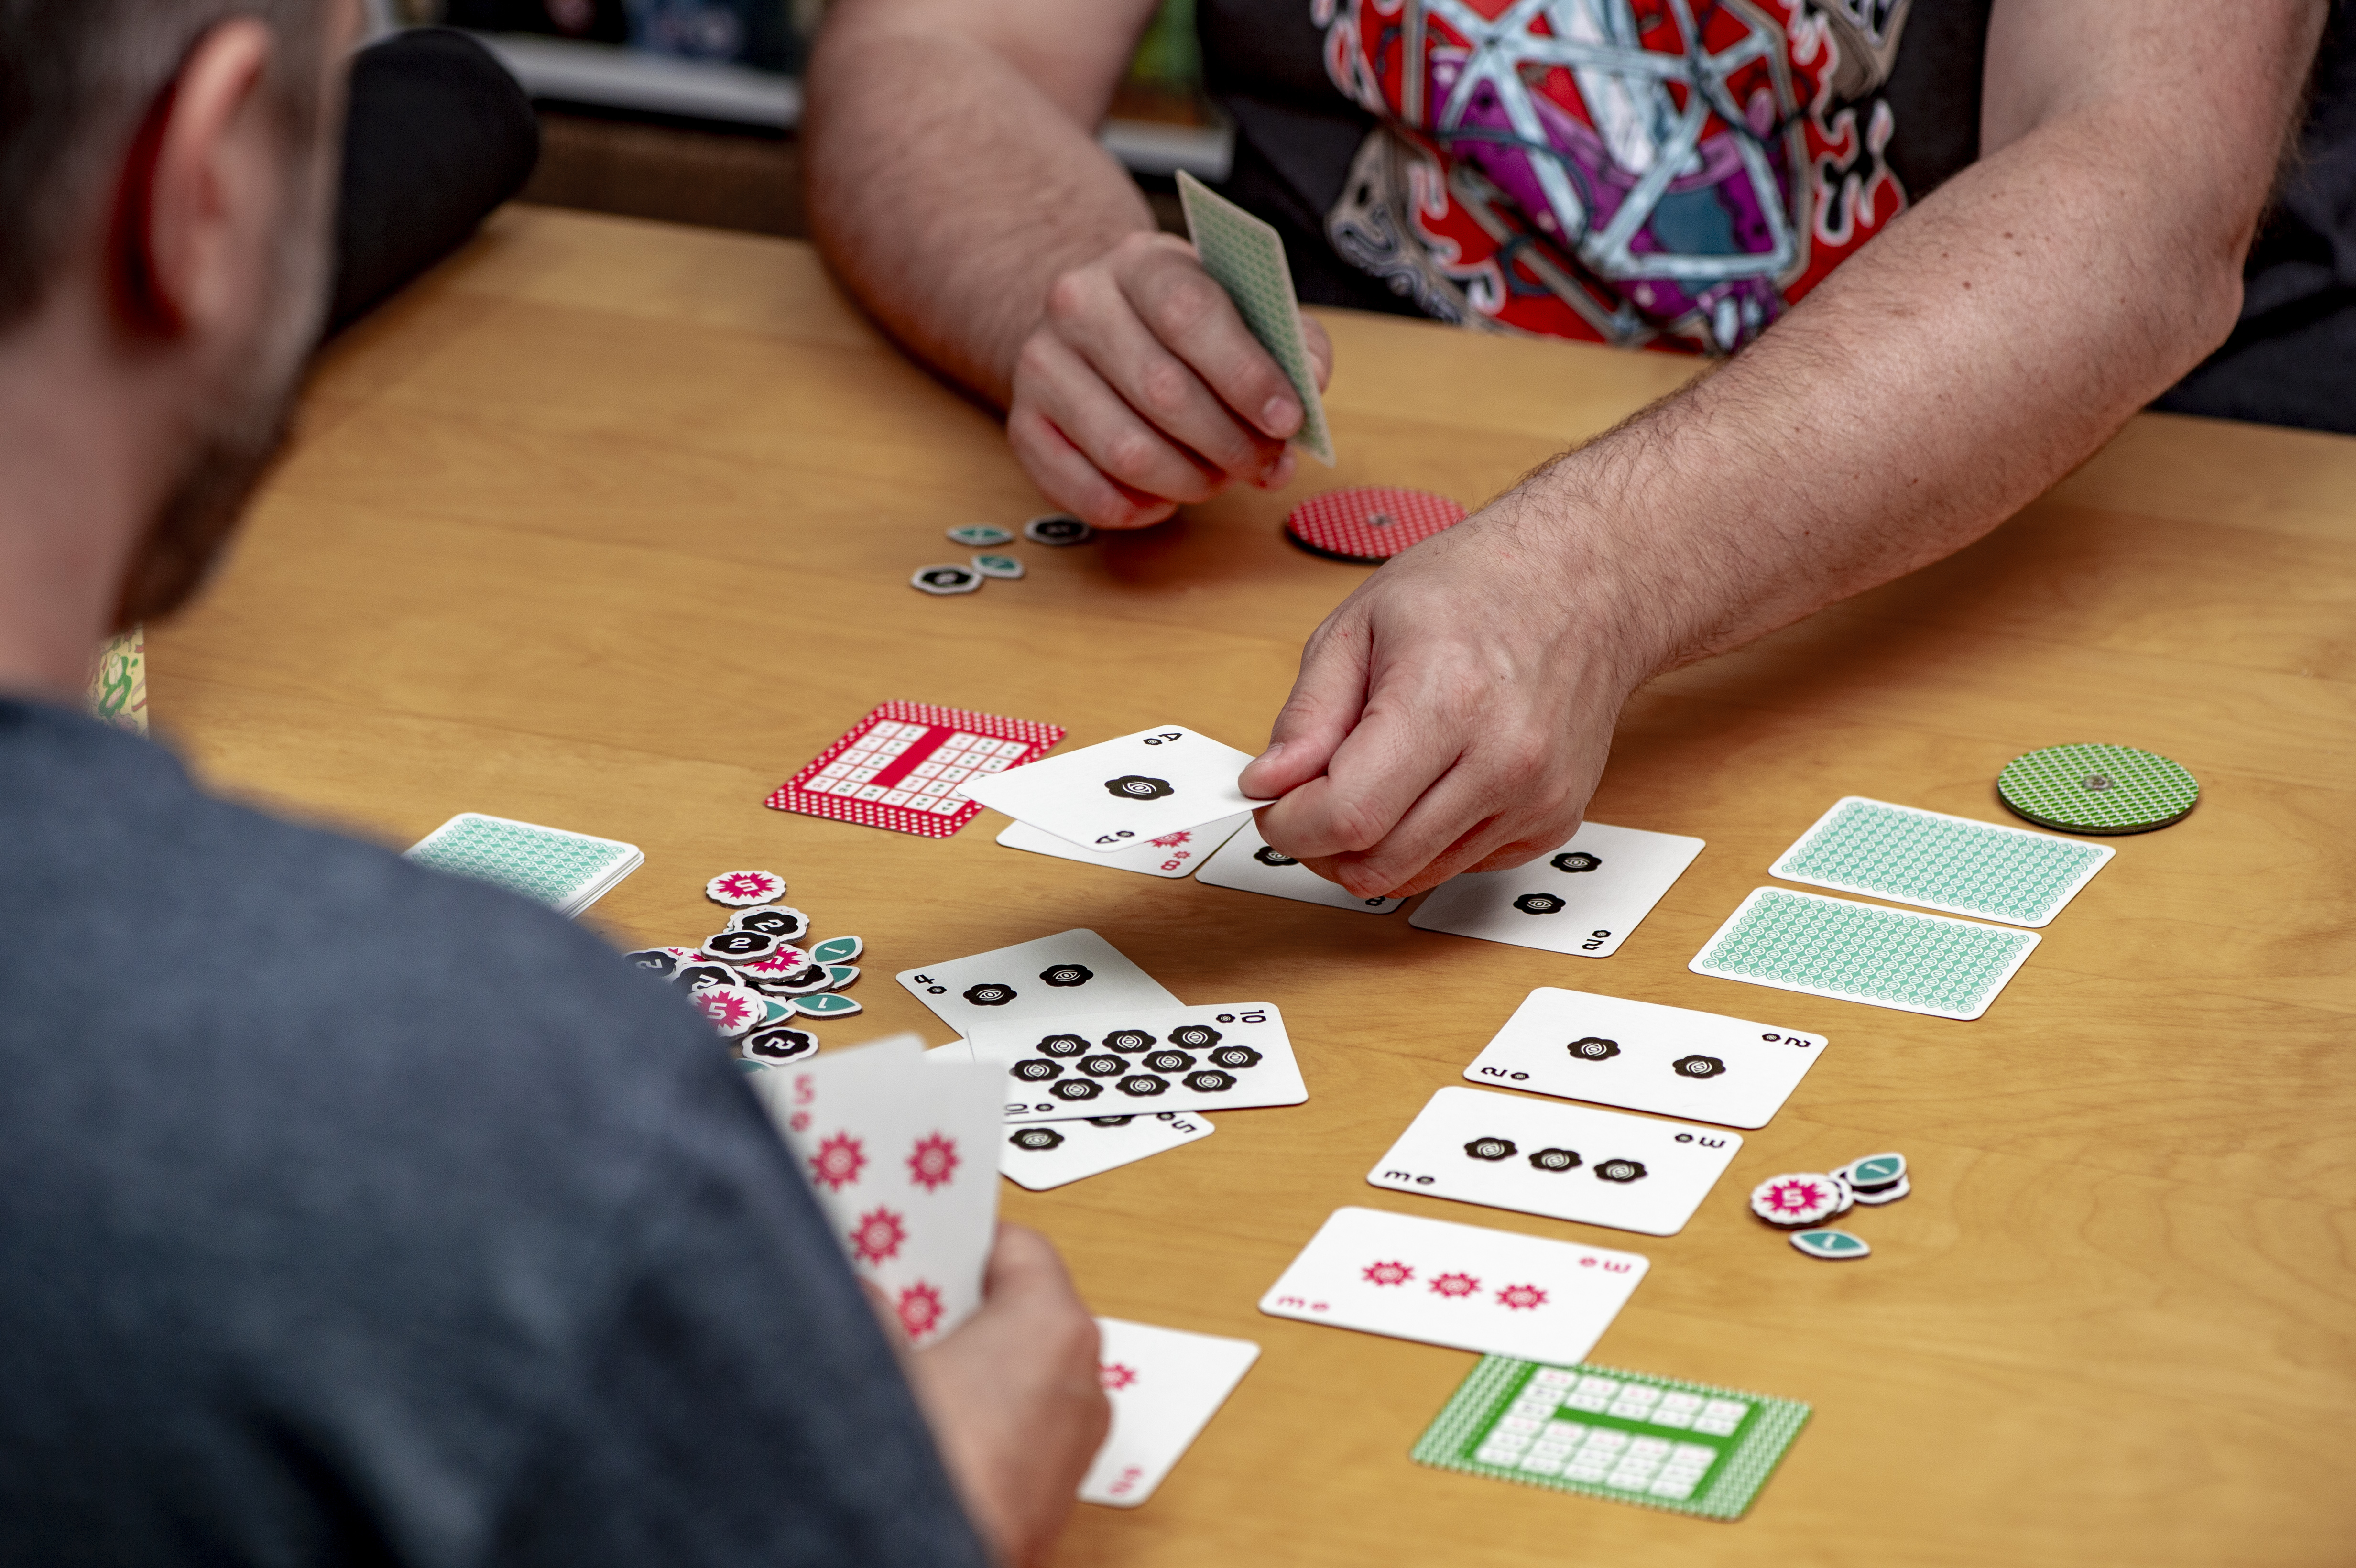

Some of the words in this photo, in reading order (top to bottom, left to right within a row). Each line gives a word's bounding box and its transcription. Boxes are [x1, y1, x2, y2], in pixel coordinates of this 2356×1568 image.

[1158, 733, 1183, 741] A
[1095, 836, 1120, 844] A
[1160, 860, 1181, 871] 8
[735, 879, 759, 892] 5
[1365, 896, 1385, 906] 8
[754, 919, 784, 931] 2
[729, 937, 751, 948] 2
[1582, 939, 1604, 950] 2
[914, 974, 935, 984] 4
[706, 1002, 728, 1020] 5
[1240, 1010, 1266, 1023] 10
[764, 1037, 796, 1050] 2
[1784, 1037, 1811, 1047] 2
[1481, 1067, 1508, 1078] 2
[793, 1073, 816, 1105] 5
[1171, 1120, 1197, 1133] 5
[1699, 1137, 1726, 1148] 3
[1384, 1171, 1410, 1182] 3
[1782, 1188, 1805, 1207] 5
